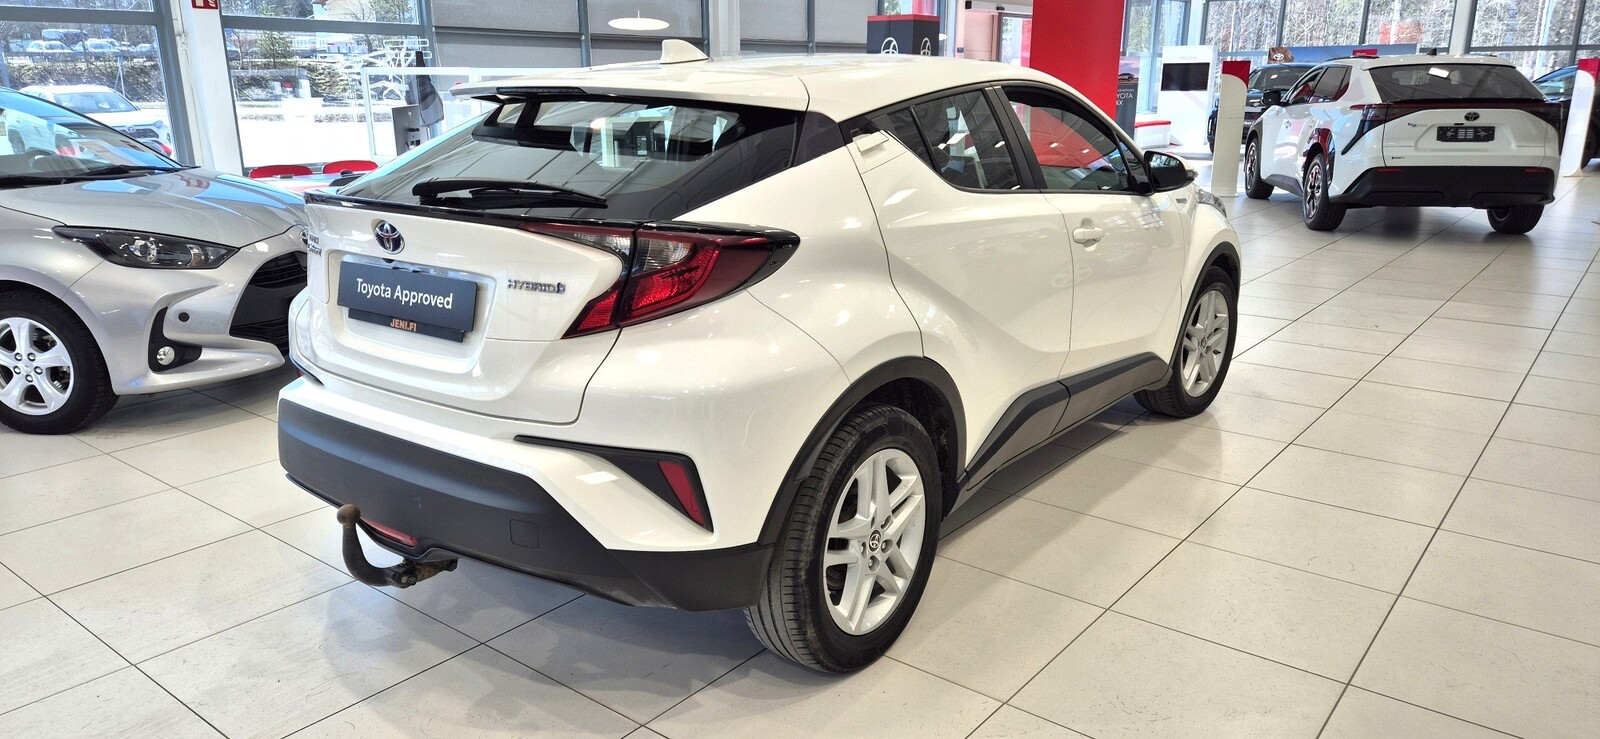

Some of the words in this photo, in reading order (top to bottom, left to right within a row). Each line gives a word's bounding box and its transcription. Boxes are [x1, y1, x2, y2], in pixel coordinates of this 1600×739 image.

[356, 277, 392, 299] Toyota
[394, 284, 454, 310] Approved
[507, 279, 556, 294] HYBRID
[389, 318, 417, 332] JENI.FI
